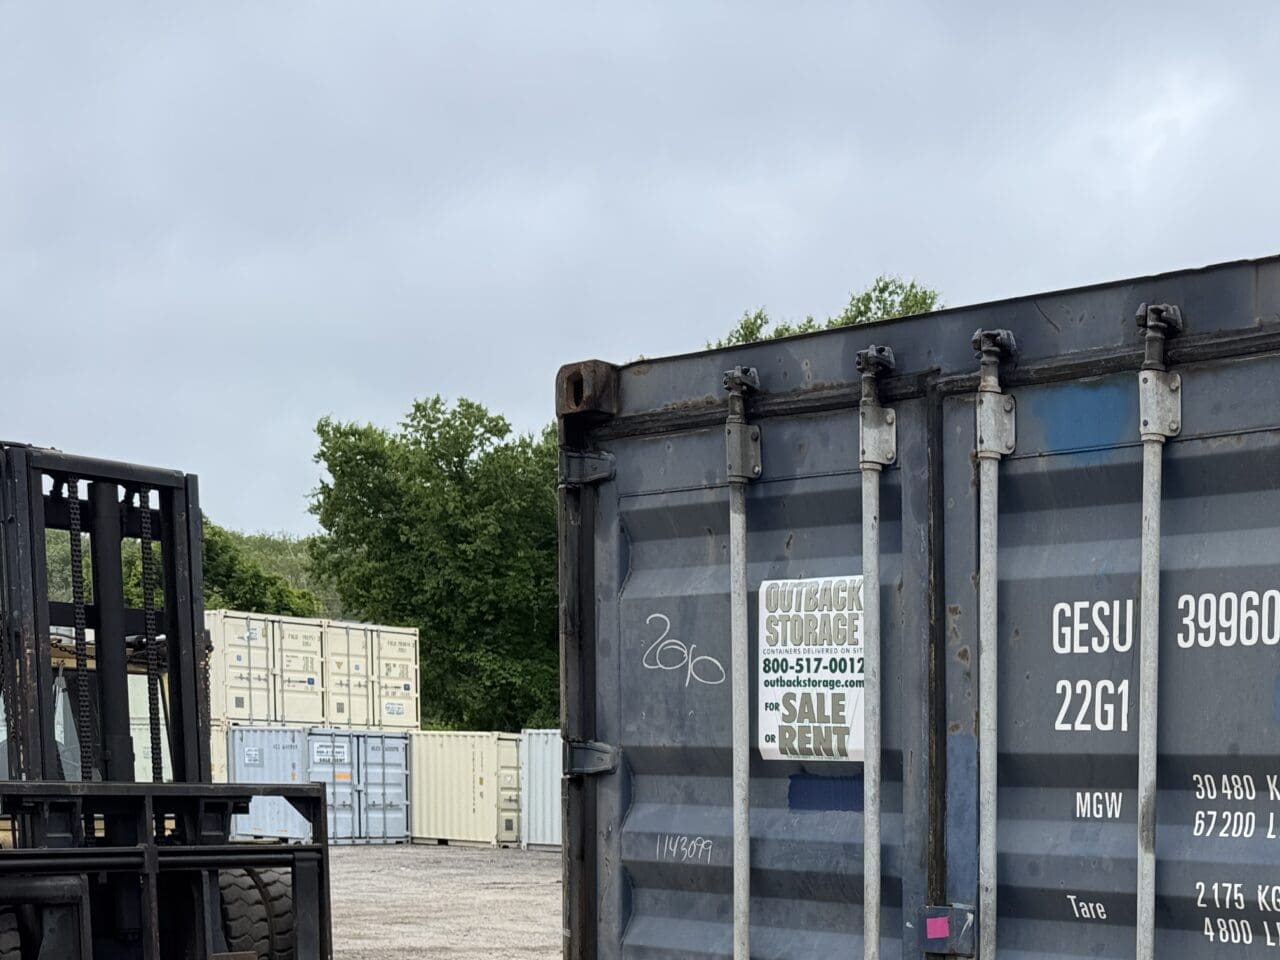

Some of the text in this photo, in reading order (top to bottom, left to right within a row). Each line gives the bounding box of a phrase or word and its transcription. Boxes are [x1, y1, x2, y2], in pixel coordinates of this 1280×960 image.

[764, 579, 864, 613] OUTBACK
[765, 613, 860, 647] STORAGE
[1052, 599, 1134, 654] GESU
[762, 647, 801, 655] CONTAINERS
[802, 647, 839, 655] DELIVERED
[762, 657, 865, 674] 800-517-0012
[763, 675, 865, 690] outbackstorage.com
[764, 691, 846, 725] FOR SALE
[1054, 679, 1130, 732] 22G1
[764, 724, 850, 757] OR RENT
[1075, 791, 1123, 819] MGW
[656, 833, 713, 865] 1143099
[1066, 894, 1108, 920] Tare
